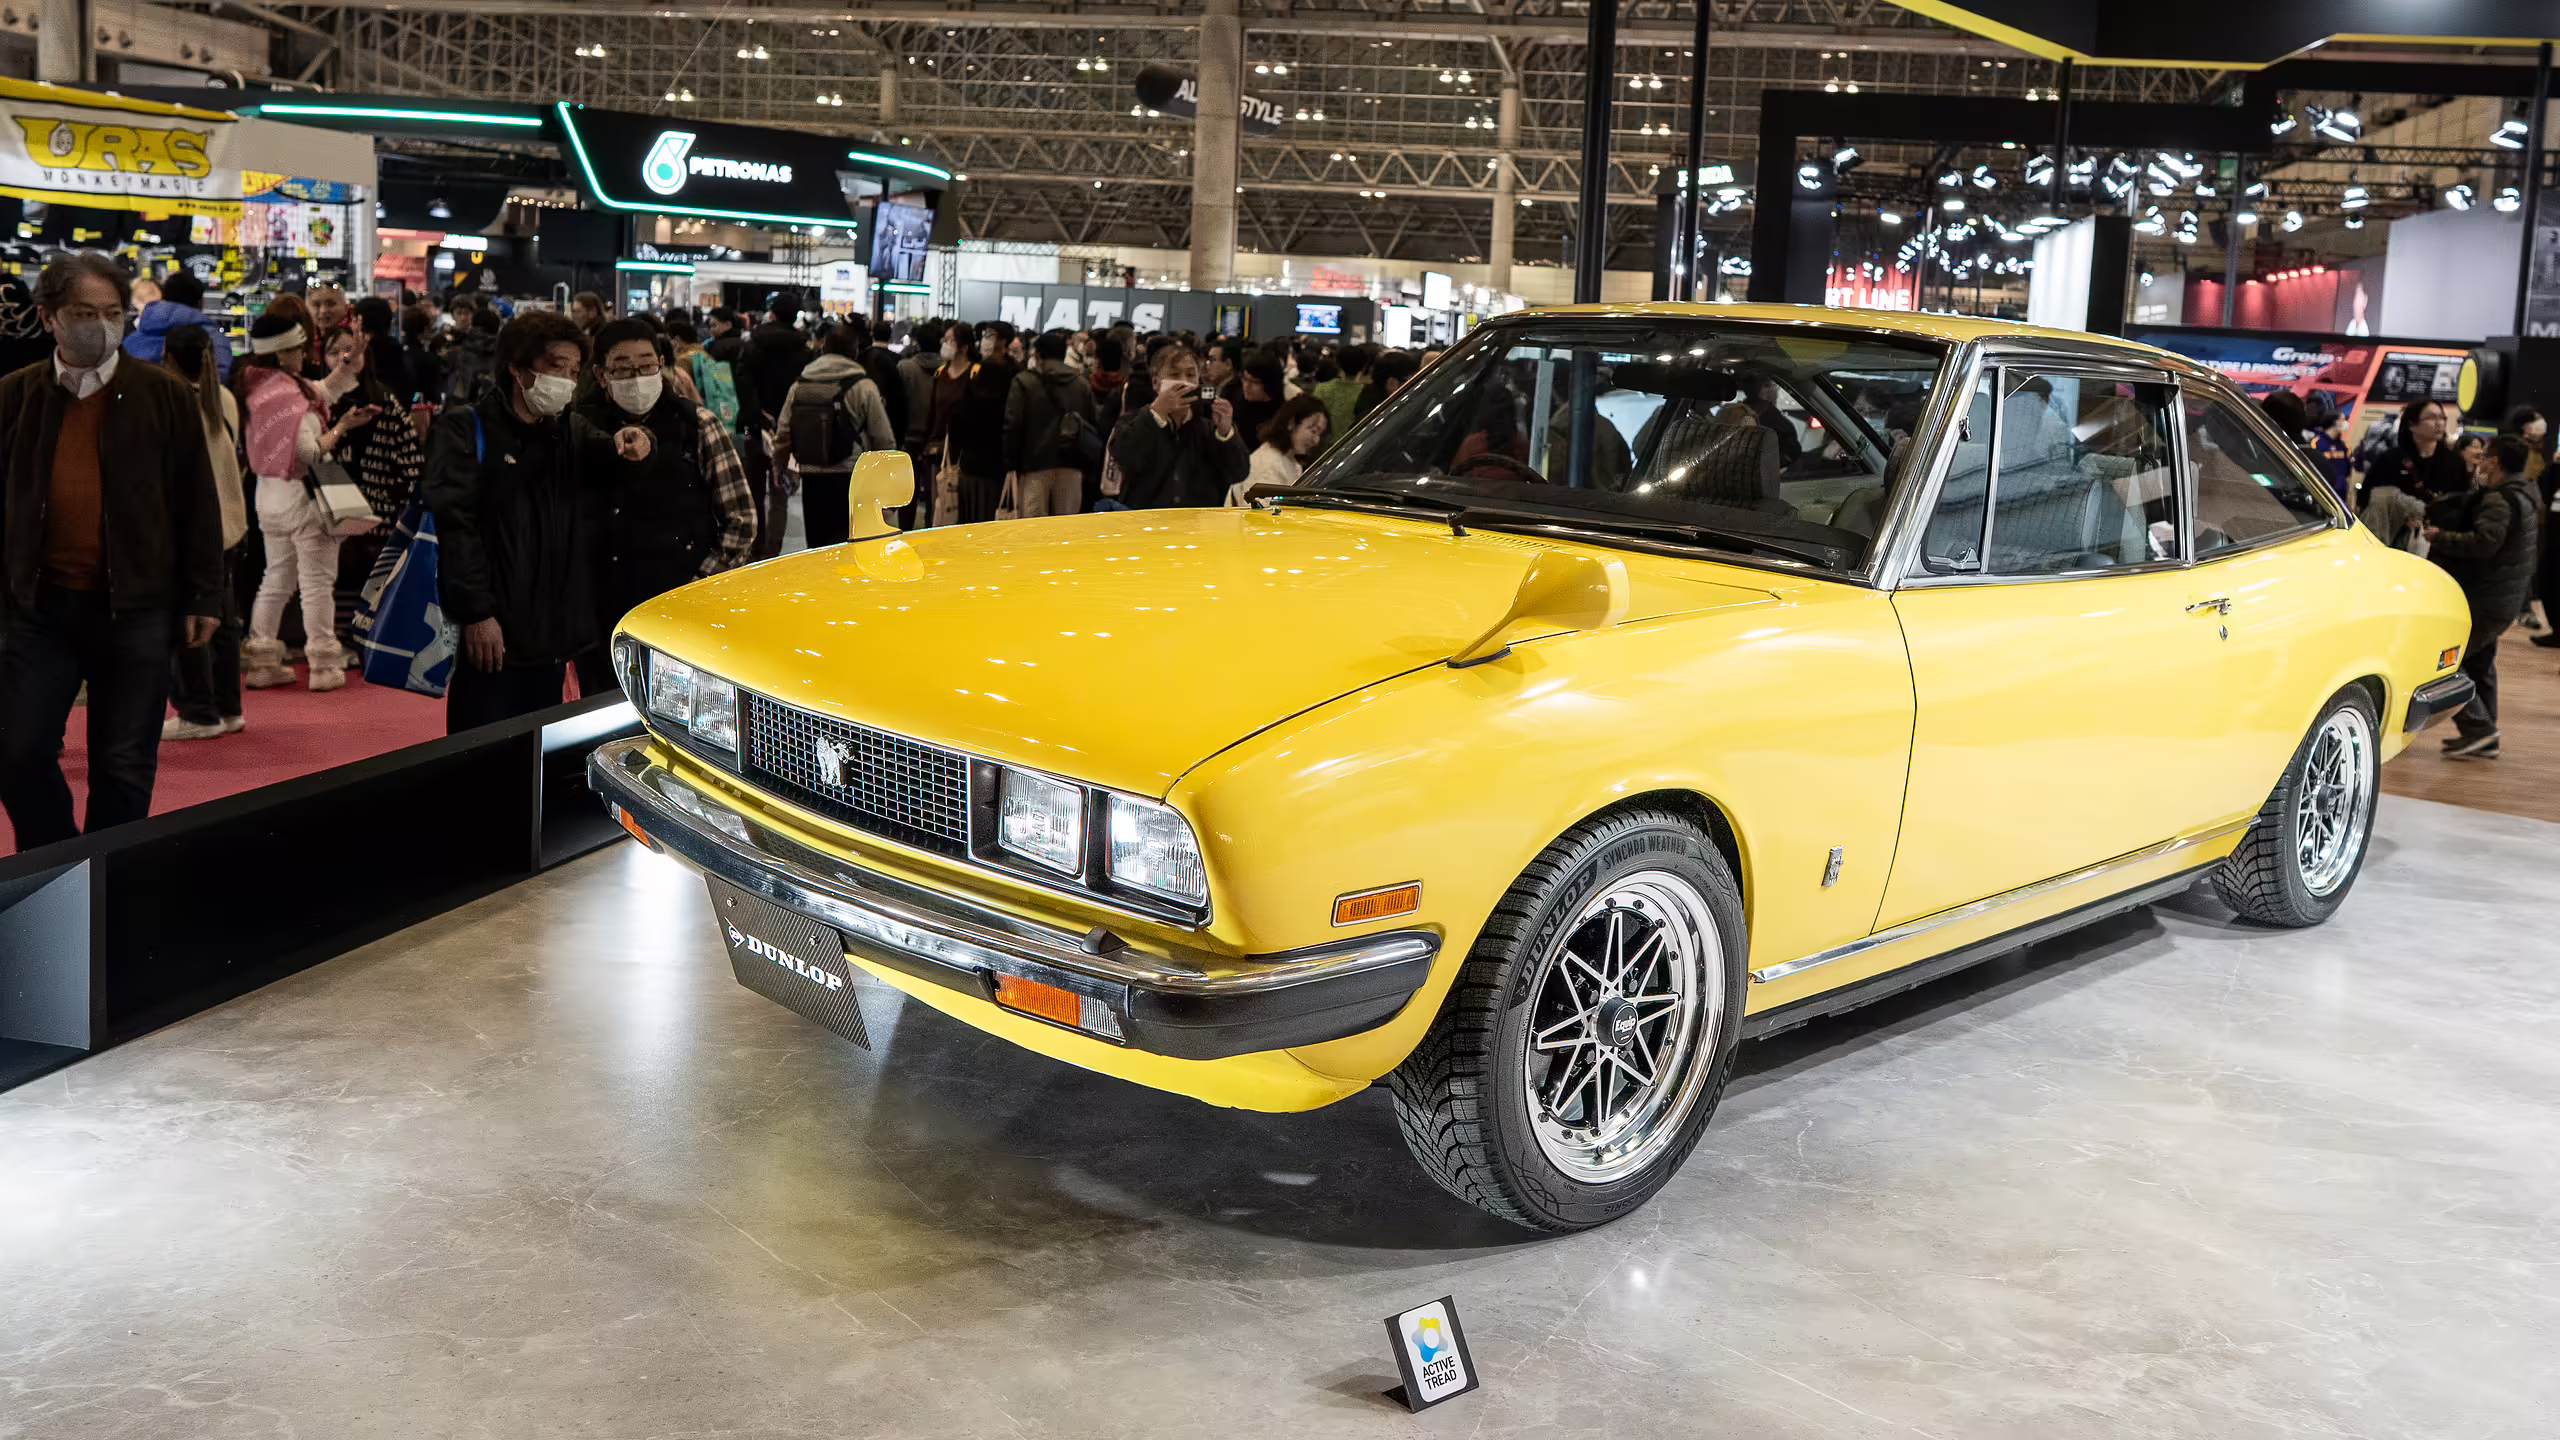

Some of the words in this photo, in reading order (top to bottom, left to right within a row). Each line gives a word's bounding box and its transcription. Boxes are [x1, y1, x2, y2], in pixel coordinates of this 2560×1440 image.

[11, 114, 212, 179] URAS
[689, 155, 793, 184] PETRONAS
[1000, 295, 1166, 334] NATS
[1858, 287, 1911, 312] LINE
[1603, 838, 1646, 870] SYNCHRO
[1648, 835, 1687, 856] WEATHER
[1521, 870, 1591, 986] DUNLOP
[746, 933, 843, 992] DUNLOP
[1615, 1014, 1637, 1033] Equip
[1422, 1355, 1456, 1379] ACTIVE
[1425, 1369, 1457, 1391] TREAD
